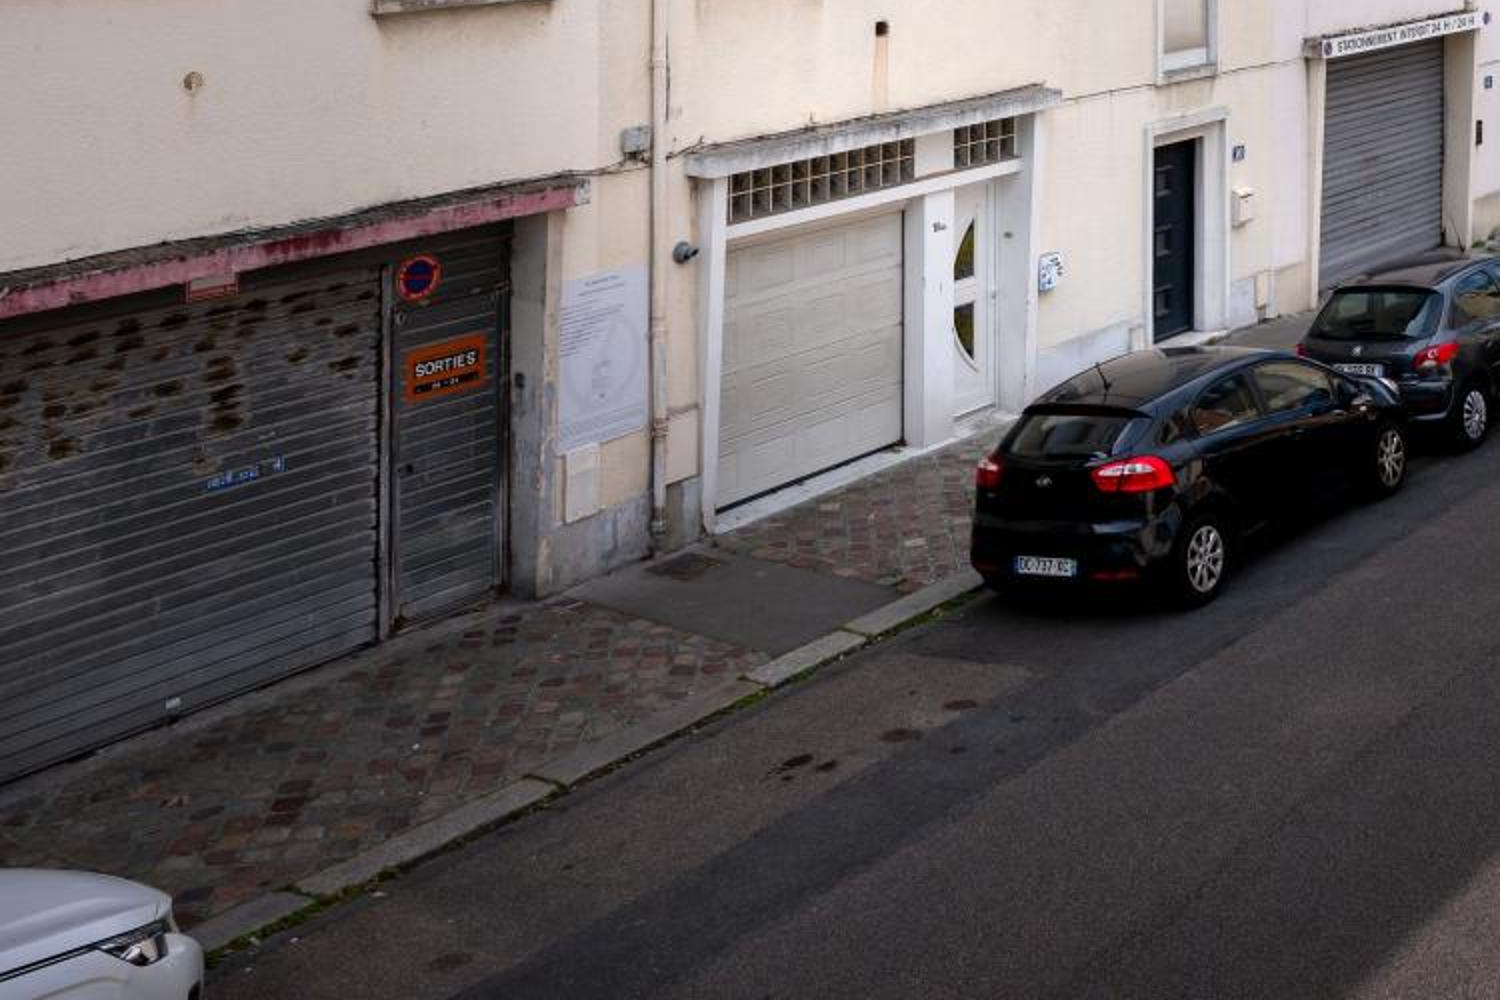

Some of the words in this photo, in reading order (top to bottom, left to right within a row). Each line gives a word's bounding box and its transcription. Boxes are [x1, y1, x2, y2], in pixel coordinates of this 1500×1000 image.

[1337, 31, 1397, 53] STATIONNEMENT
[1400, 23, 1430, 41] INTERDIT
[415, 351, 477, 377] SORTIES
